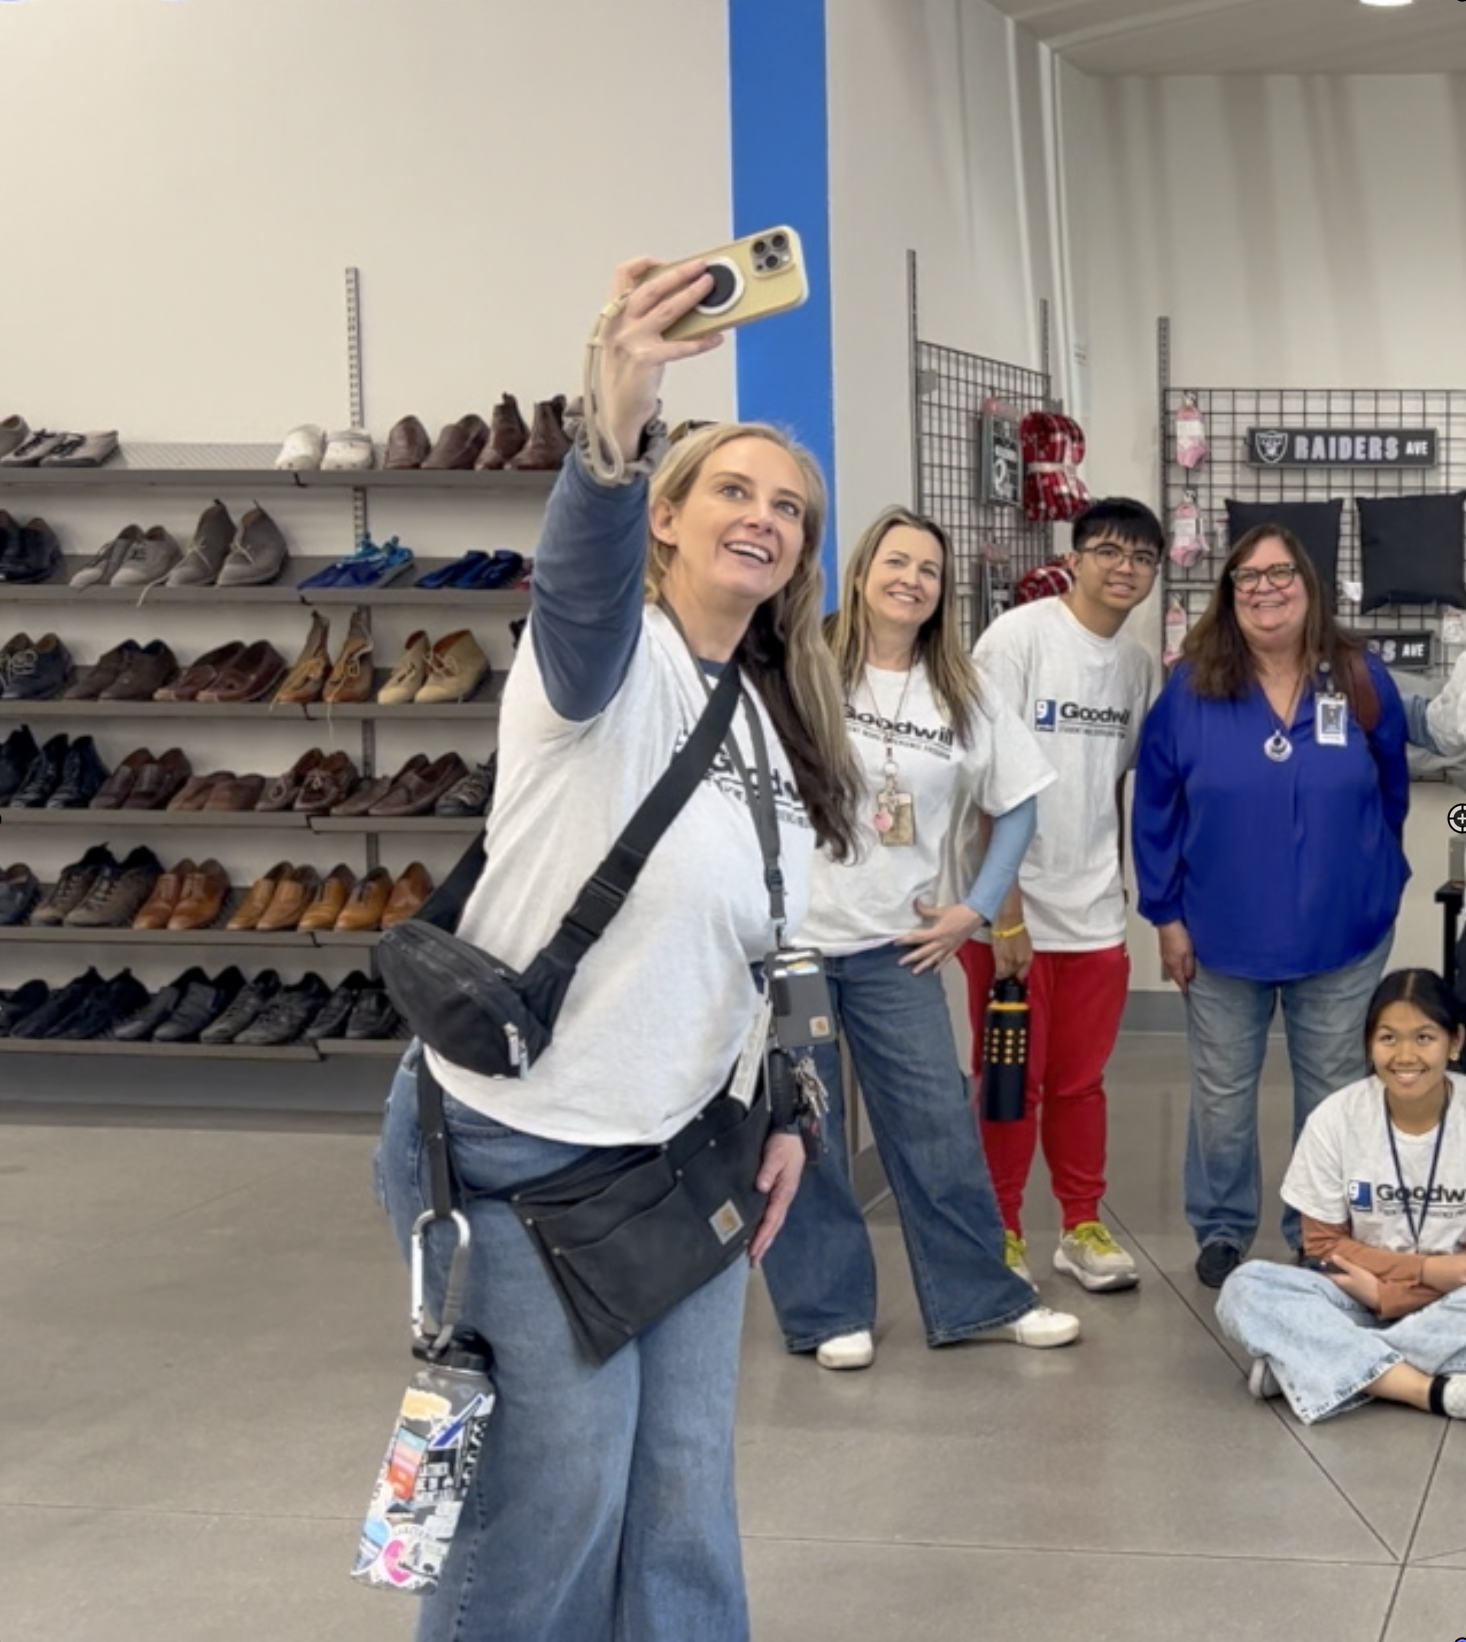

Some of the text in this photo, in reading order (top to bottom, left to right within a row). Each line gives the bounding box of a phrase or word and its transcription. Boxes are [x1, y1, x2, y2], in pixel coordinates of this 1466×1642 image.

[1294, 435, 1429, 461] RAIDERS AVE
[1402, 642, 1425, 658] AVE
